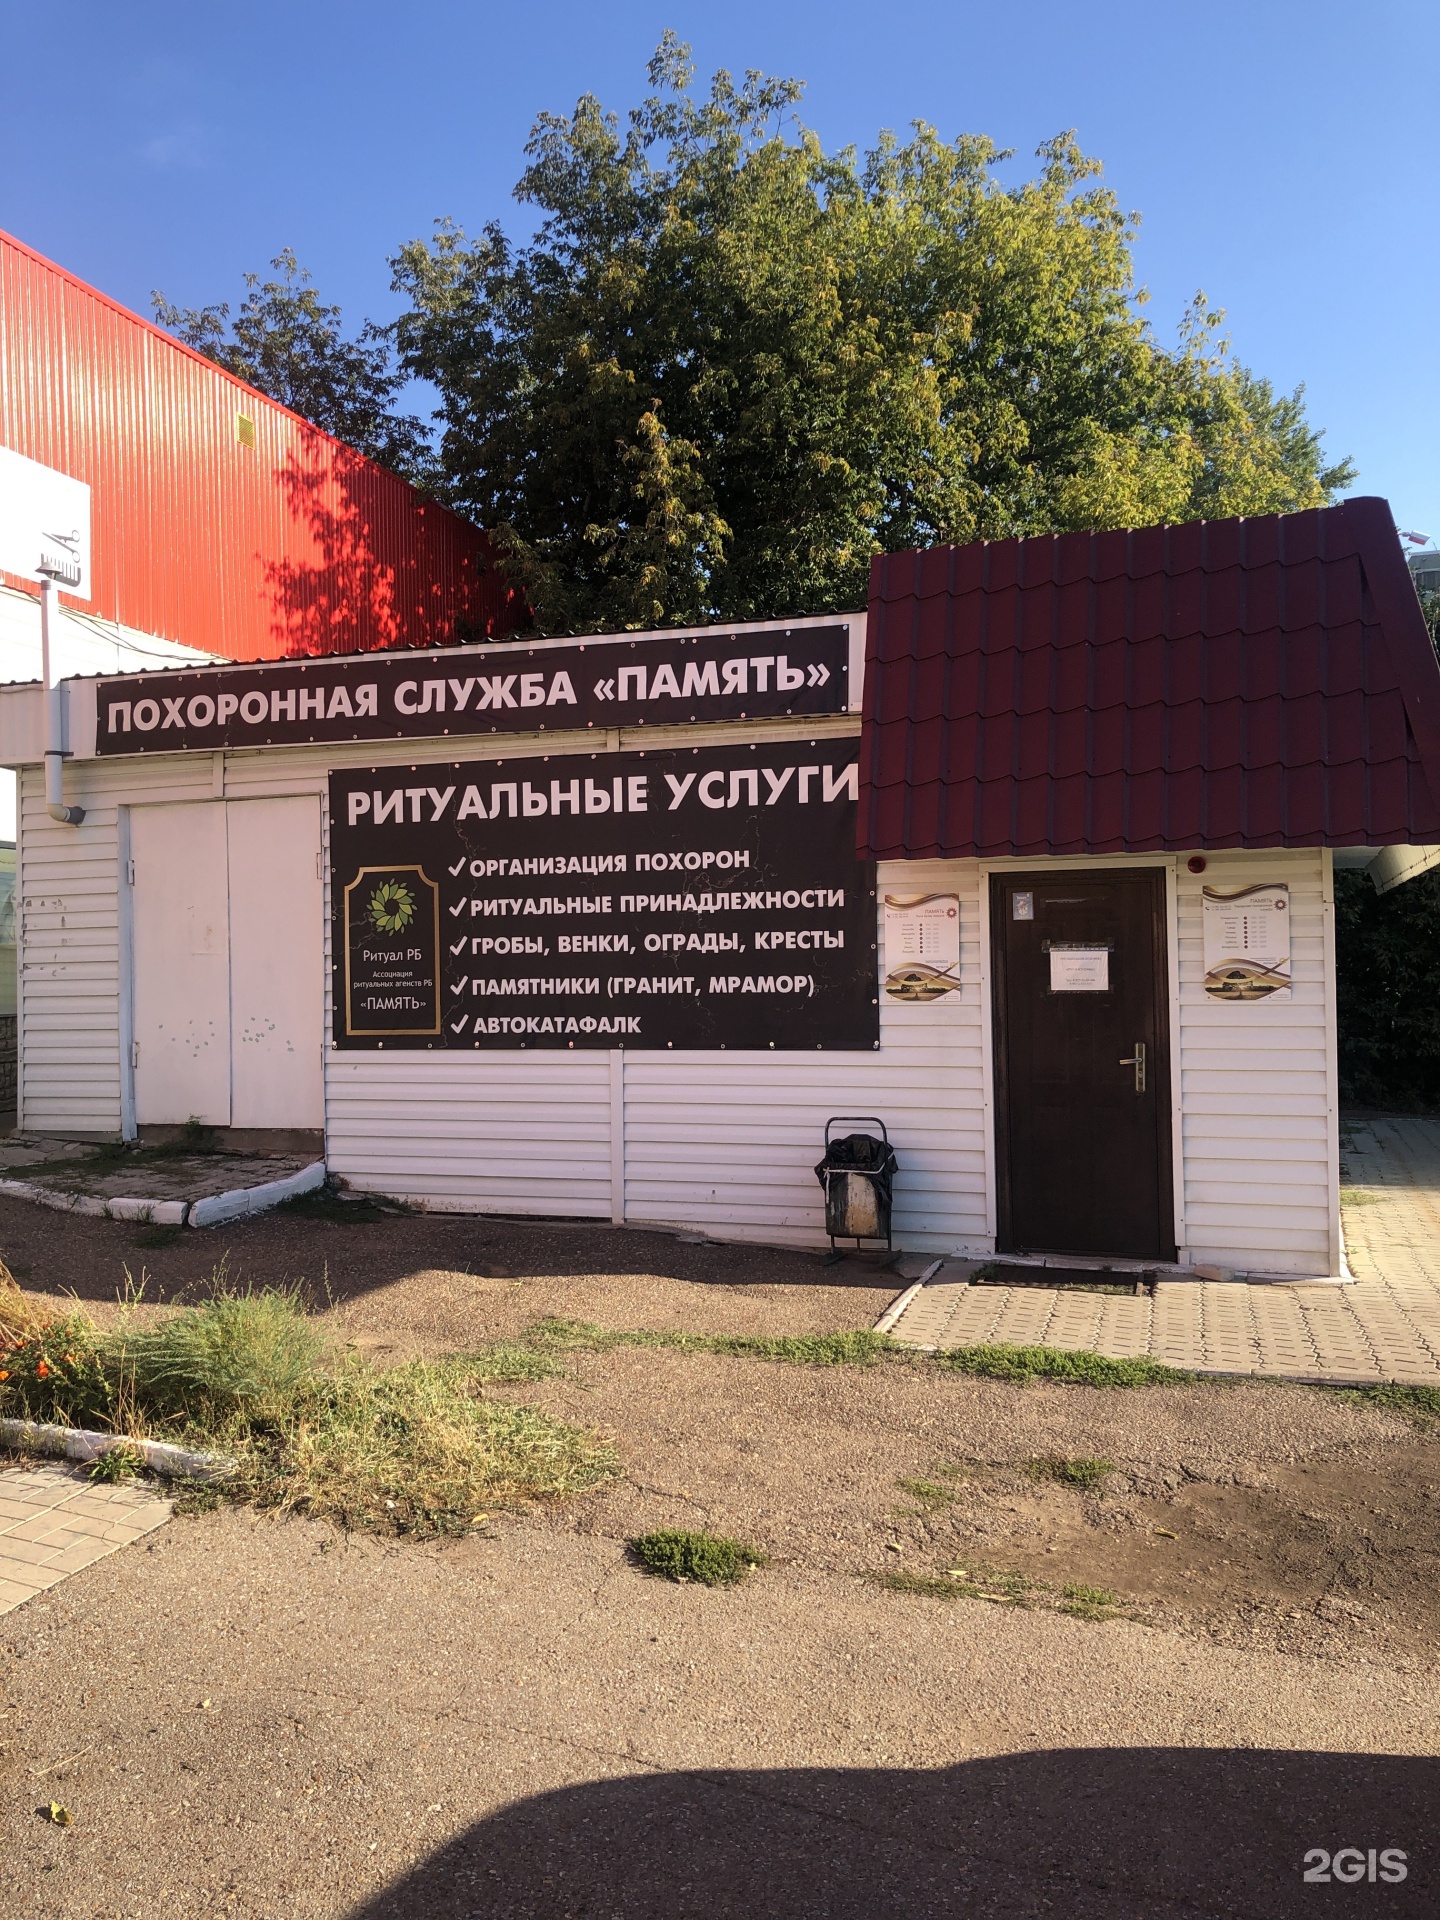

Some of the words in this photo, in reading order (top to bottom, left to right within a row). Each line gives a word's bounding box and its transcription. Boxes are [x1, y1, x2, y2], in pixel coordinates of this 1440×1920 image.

[107, 683, 378, 733] ПОХОРОННАЯ
[394, 671, 578, 714] СЛУЖБА
[593, 655, 831, 702] «ПАМЯТЬ»
[347, 776, 648, 826] РИТУАЛЬНЫЕ
[664, 763, 859, 810] УСЛУГИ
[469, 854, 627, 877] ОРГАНИЗАЦИЯ
[635, 850, 750, 872] ПОХОРОН
[470, 895, 612, 916] РИТУАЛЬНЫЕ
[620, 889, 845, 913] ПРИНАДЛЕЖНОСТИ
[471, 936, 550, 956] ГРОБЫ,
[558, 934, 636, 955] ВЕНКИ,
[643, 932, 746, 954] ОГРАДЫ,
[754, 930, 845, 950] КРЕСТЫ
[363, 949, 403, 964] Ритуал
[407, 948, 422, 961] РБ
[353, 981, 394, 990] ритуальных
[423, 979, 433, 987] РБ
[372, 970, 413, 979] Ассоциация
[472, 977, 600, 996] ПАМЯТНИКИ
[607, 976, 701, 999] (ГРАНИТ,
[708, 974, 815, 998] МРАМОР)
[360, 996, 427, 1010] «ПАМЯТЬ»
[473, 1015, 642, 1034] АВТОКАТАФАЛК
